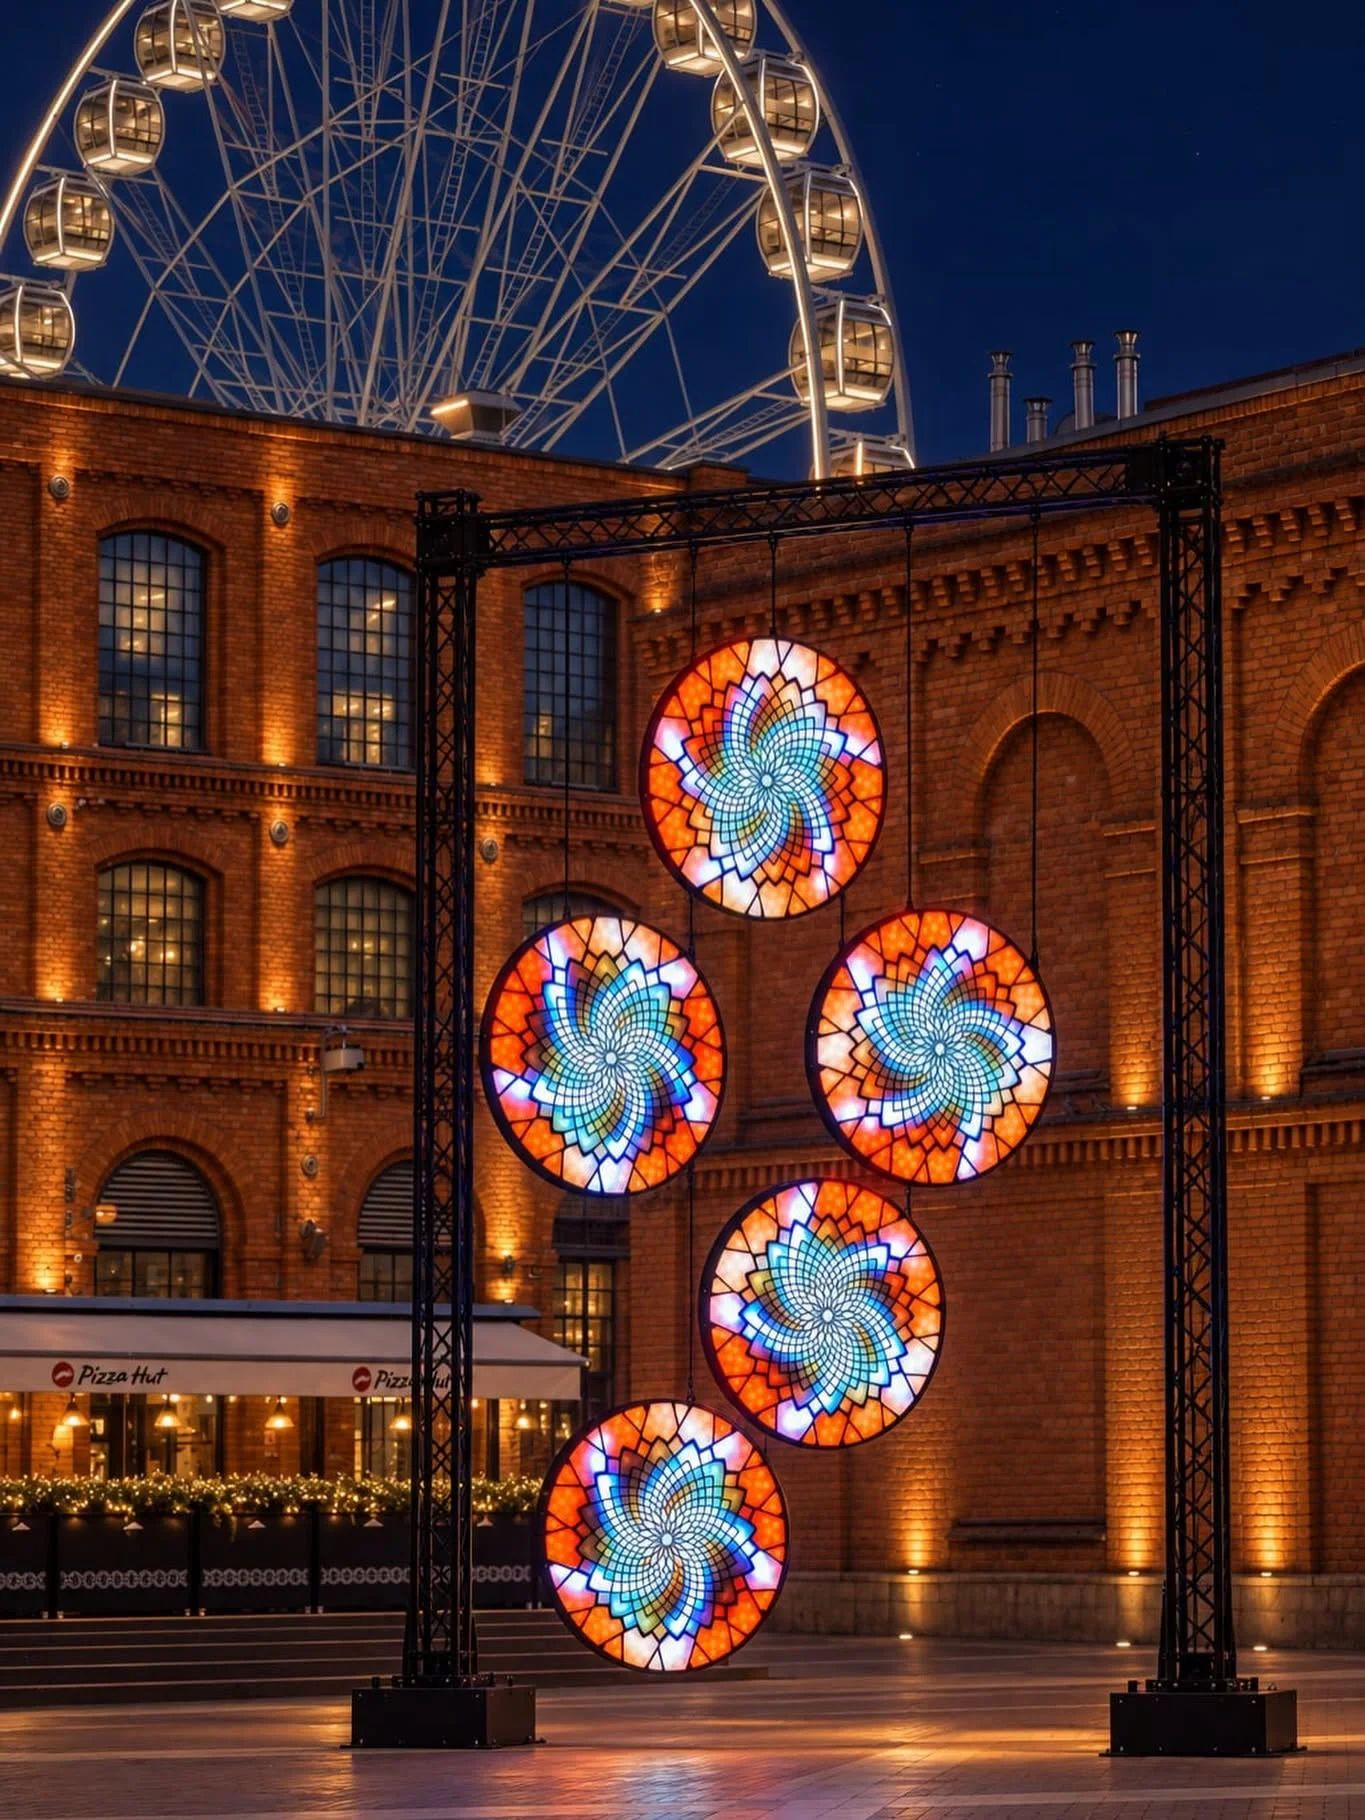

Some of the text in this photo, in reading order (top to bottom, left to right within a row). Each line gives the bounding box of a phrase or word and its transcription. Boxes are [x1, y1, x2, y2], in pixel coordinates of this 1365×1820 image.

[78, 1365, 168, 1385] Pizza Hut
[374, 1369, 416, 1389] Pizz
